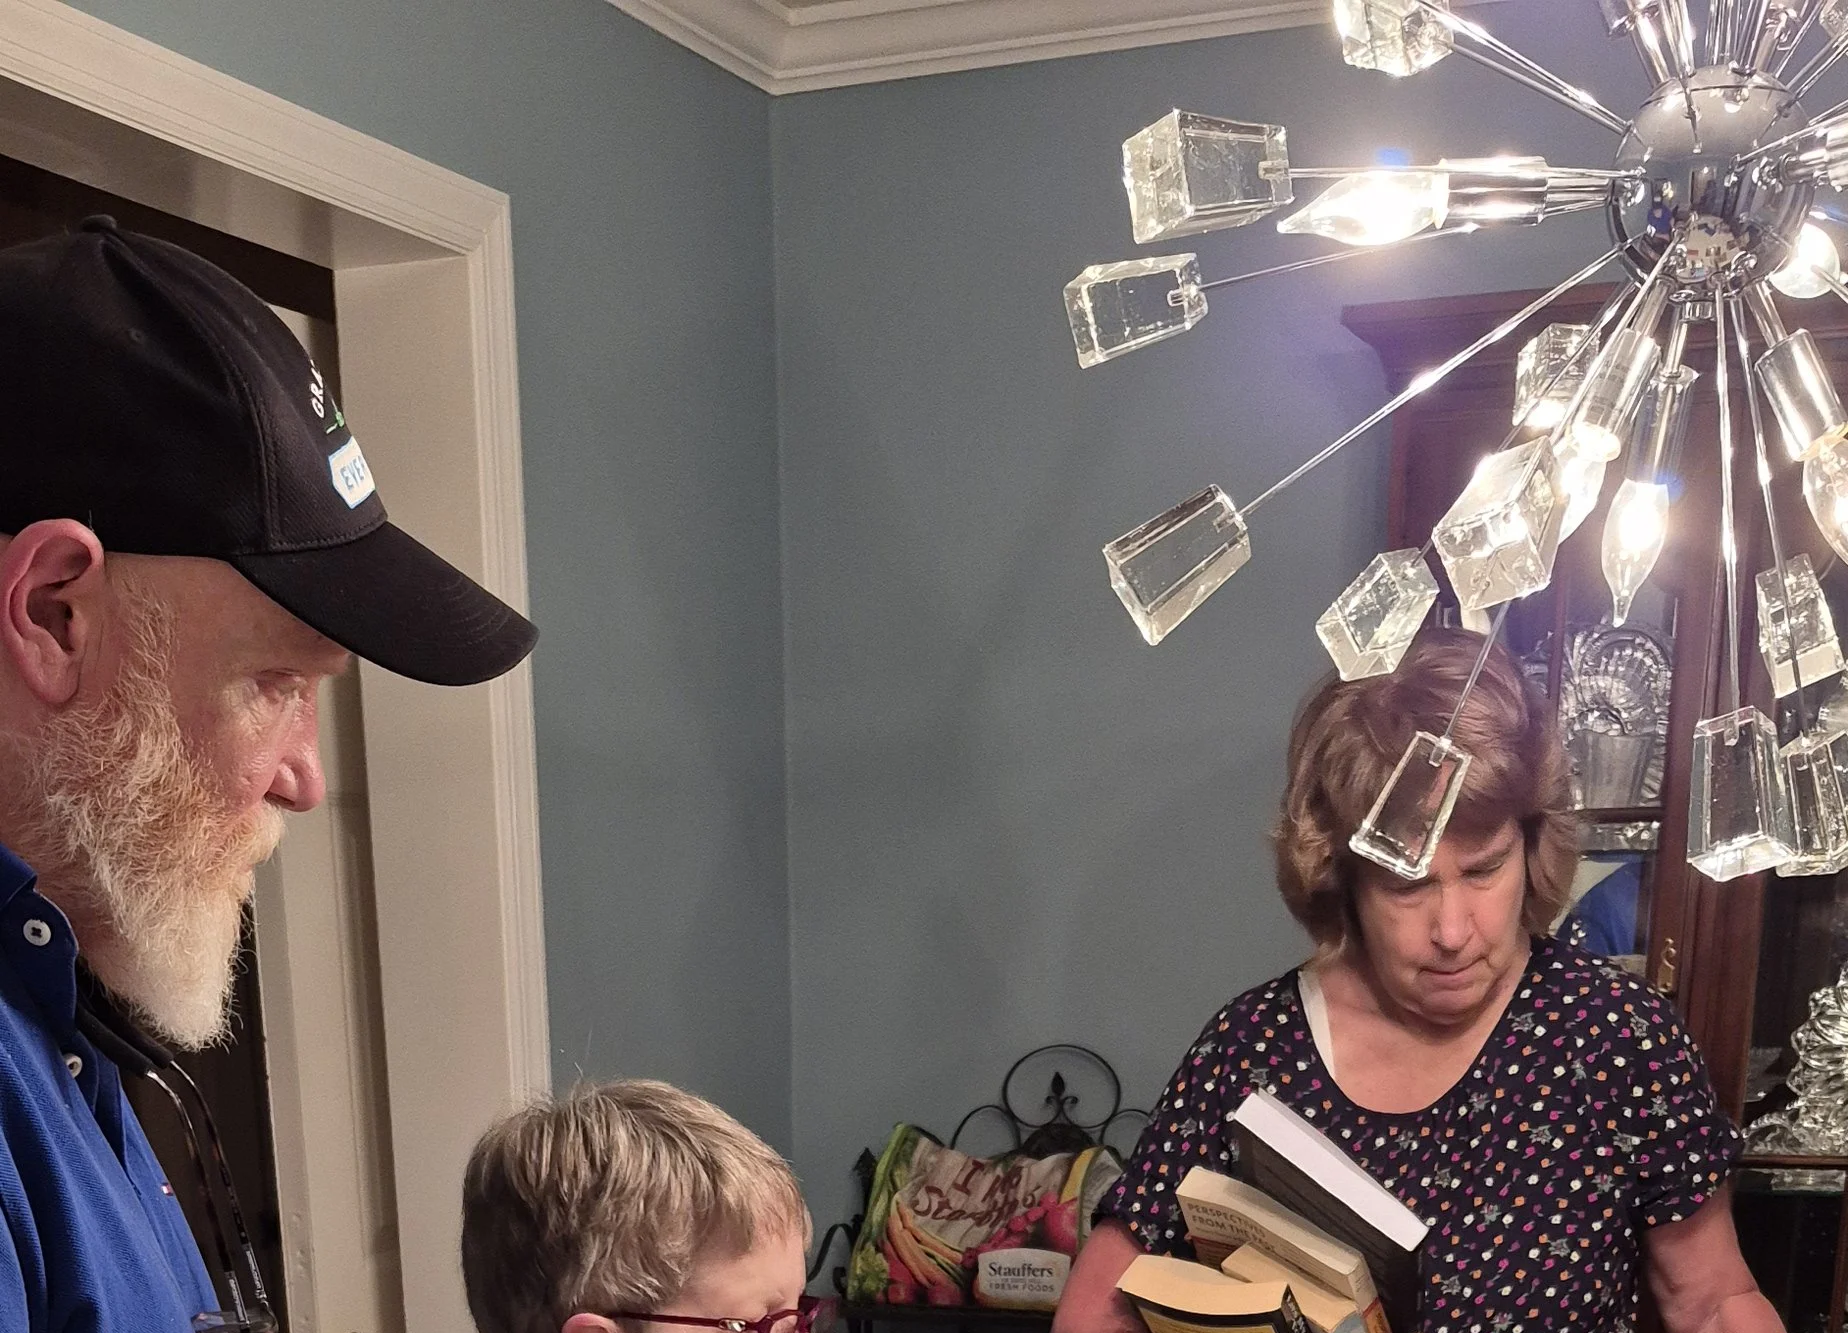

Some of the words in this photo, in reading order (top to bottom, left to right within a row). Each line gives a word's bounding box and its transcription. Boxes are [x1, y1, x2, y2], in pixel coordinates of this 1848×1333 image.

[1192, 1214, 1226, 1230] FROM
[1229, 1224, 1251, 1240] THE
[988, 1261, 1054, 1278] Stauffers
[1021, 1283, 1054, 1293] FOODS
